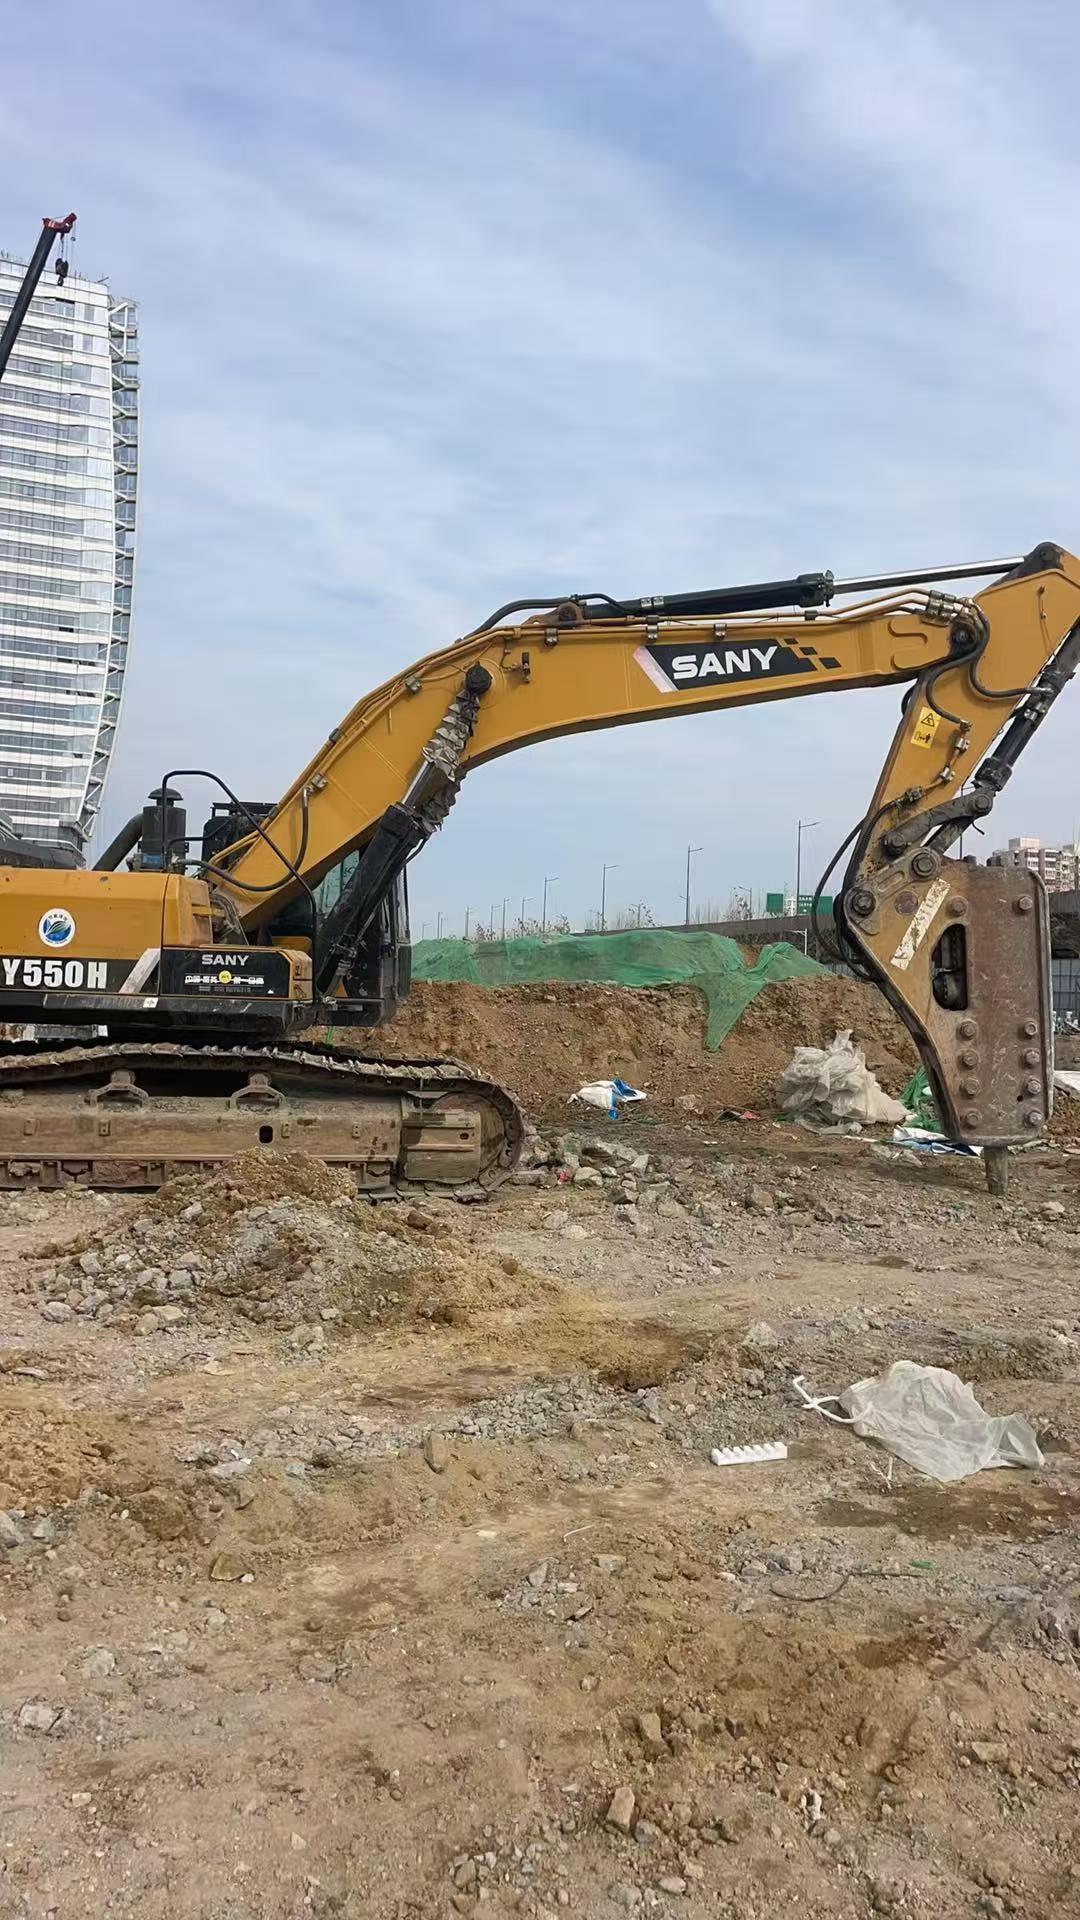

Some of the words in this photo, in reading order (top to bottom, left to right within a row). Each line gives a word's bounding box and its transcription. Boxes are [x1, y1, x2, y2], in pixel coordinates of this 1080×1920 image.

[671, 645, 778, 680] SANY
[2, 958, 108, 989] Y550H
[201, 954, 249, 966] SANY
